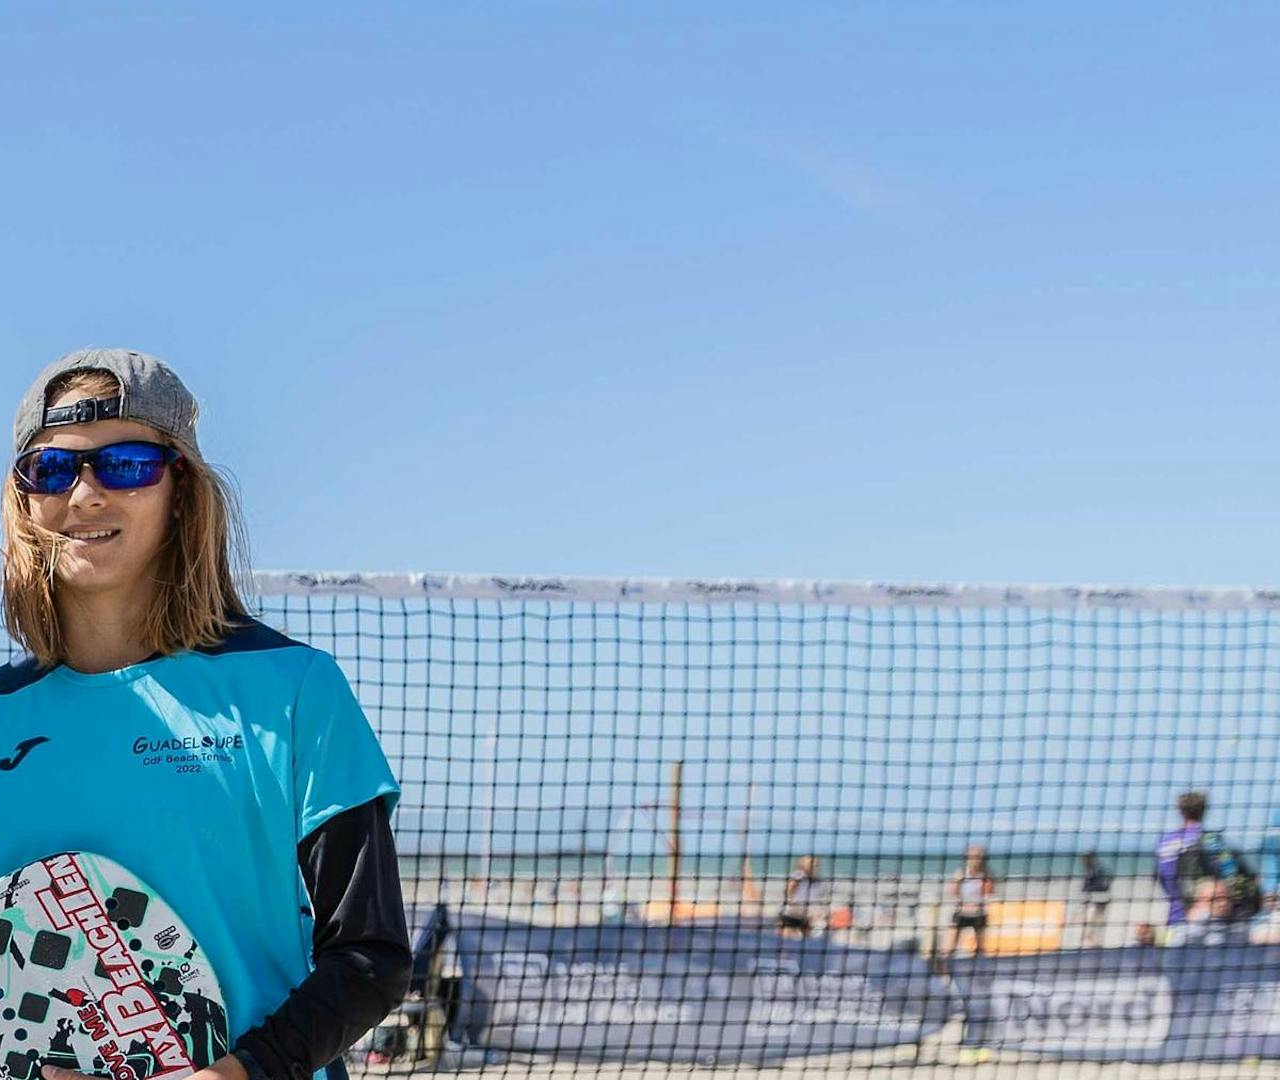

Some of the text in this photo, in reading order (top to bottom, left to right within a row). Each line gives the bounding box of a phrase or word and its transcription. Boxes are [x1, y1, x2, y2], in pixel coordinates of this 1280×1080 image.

[133, 735, 243, 755] GUADELOUPE
[166, 753, 199, 763] Beach
[202, 752, 233, 763] Tennis
[176, 764, 201, 773] 2022
